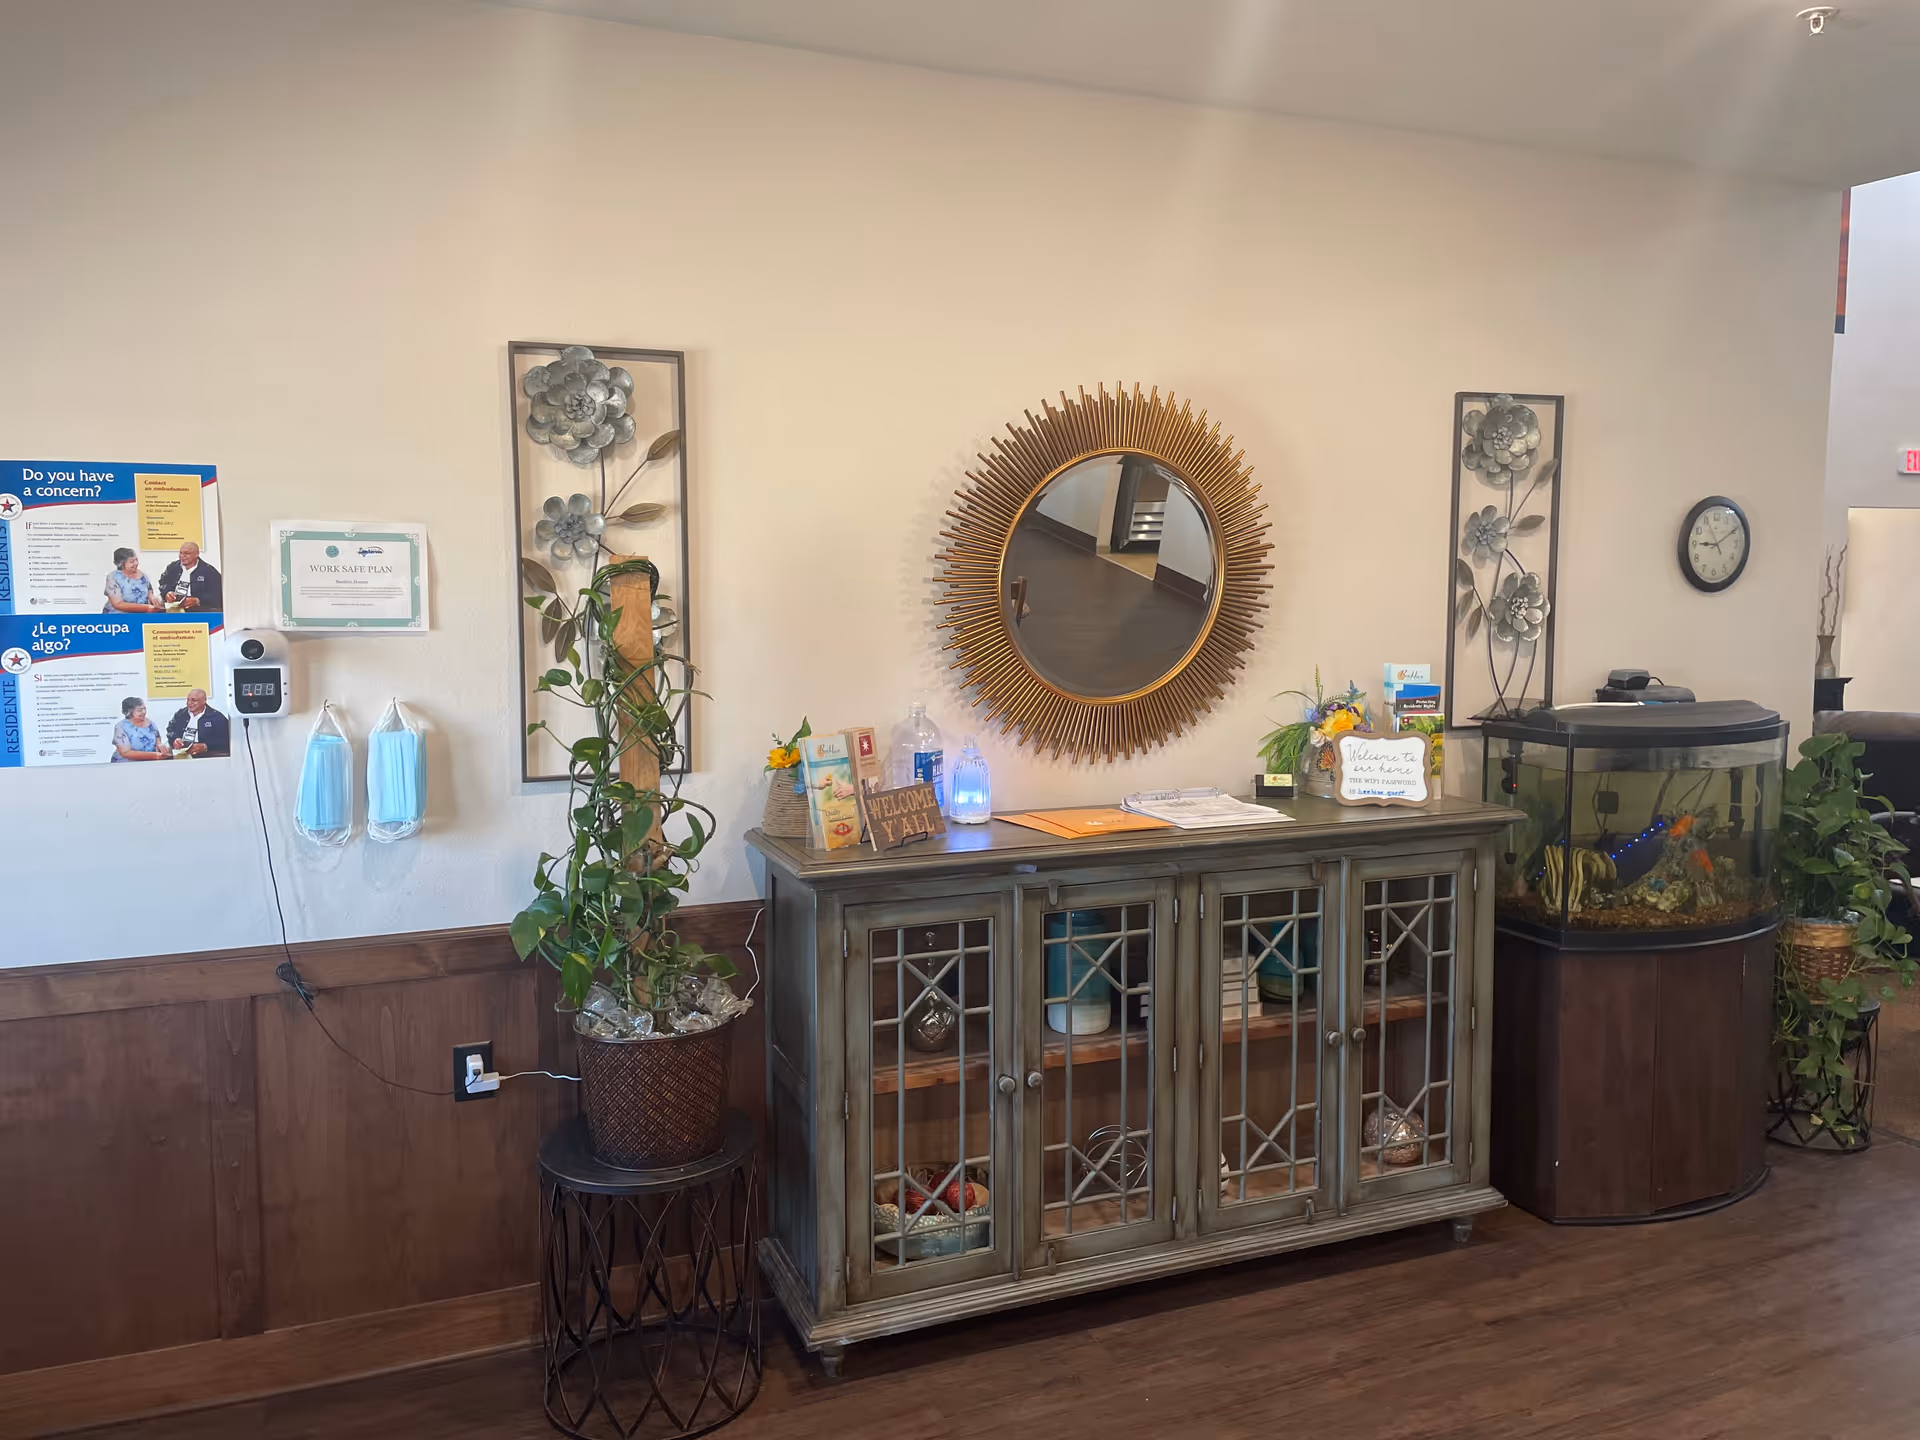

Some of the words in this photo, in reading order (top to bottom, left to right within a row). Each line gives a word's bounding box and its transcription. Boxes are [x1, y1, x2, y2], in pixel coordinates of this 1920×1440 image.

[22, 468, 43, 481] Do
[47, 471, 75, 486] you
[80, 469, 114, 482] have
[23, 487, 32, 496] a
[35, 485, 102, 498] concern?
[310, 565, 340, 573] WORK
[342, 565, 366, 573] SAFE
[31, 622, 57, 637] ¿Le
[61, 623, 130, 636] preocupa
[31, 639, 71, 654] algo?
[3, 680, 20, 754] RESIDENTE
[1346, 742, 1399, 762] Welcome
[1401, 752, 1417, 762] to
[1379, 762, 1413, 774] home
[866, 787, 936, 820] WELCOME
[881, 812, 936, 843] Y'ALL
